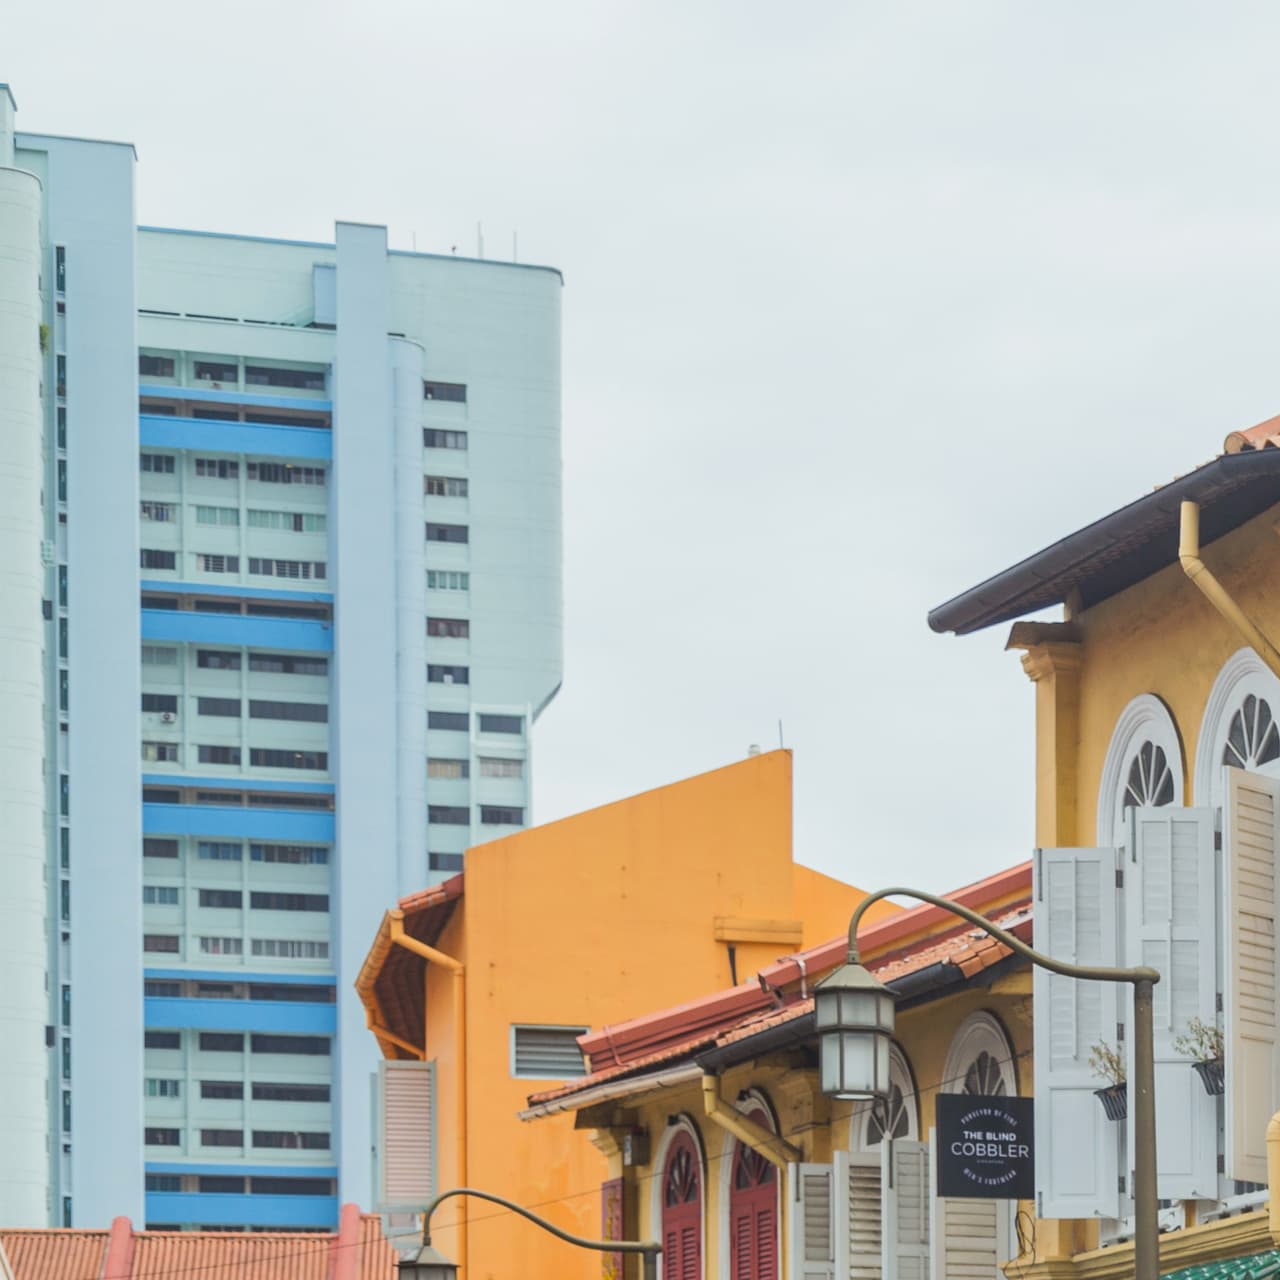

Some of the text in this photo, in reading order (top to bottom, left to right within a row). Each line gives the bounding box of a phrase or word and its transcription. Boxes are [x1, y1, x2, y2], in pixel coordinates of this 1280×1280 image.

[963, 1130, 1017, 1142] THE BLIND
[951, 1141, 1030, 1158] COBBLER
